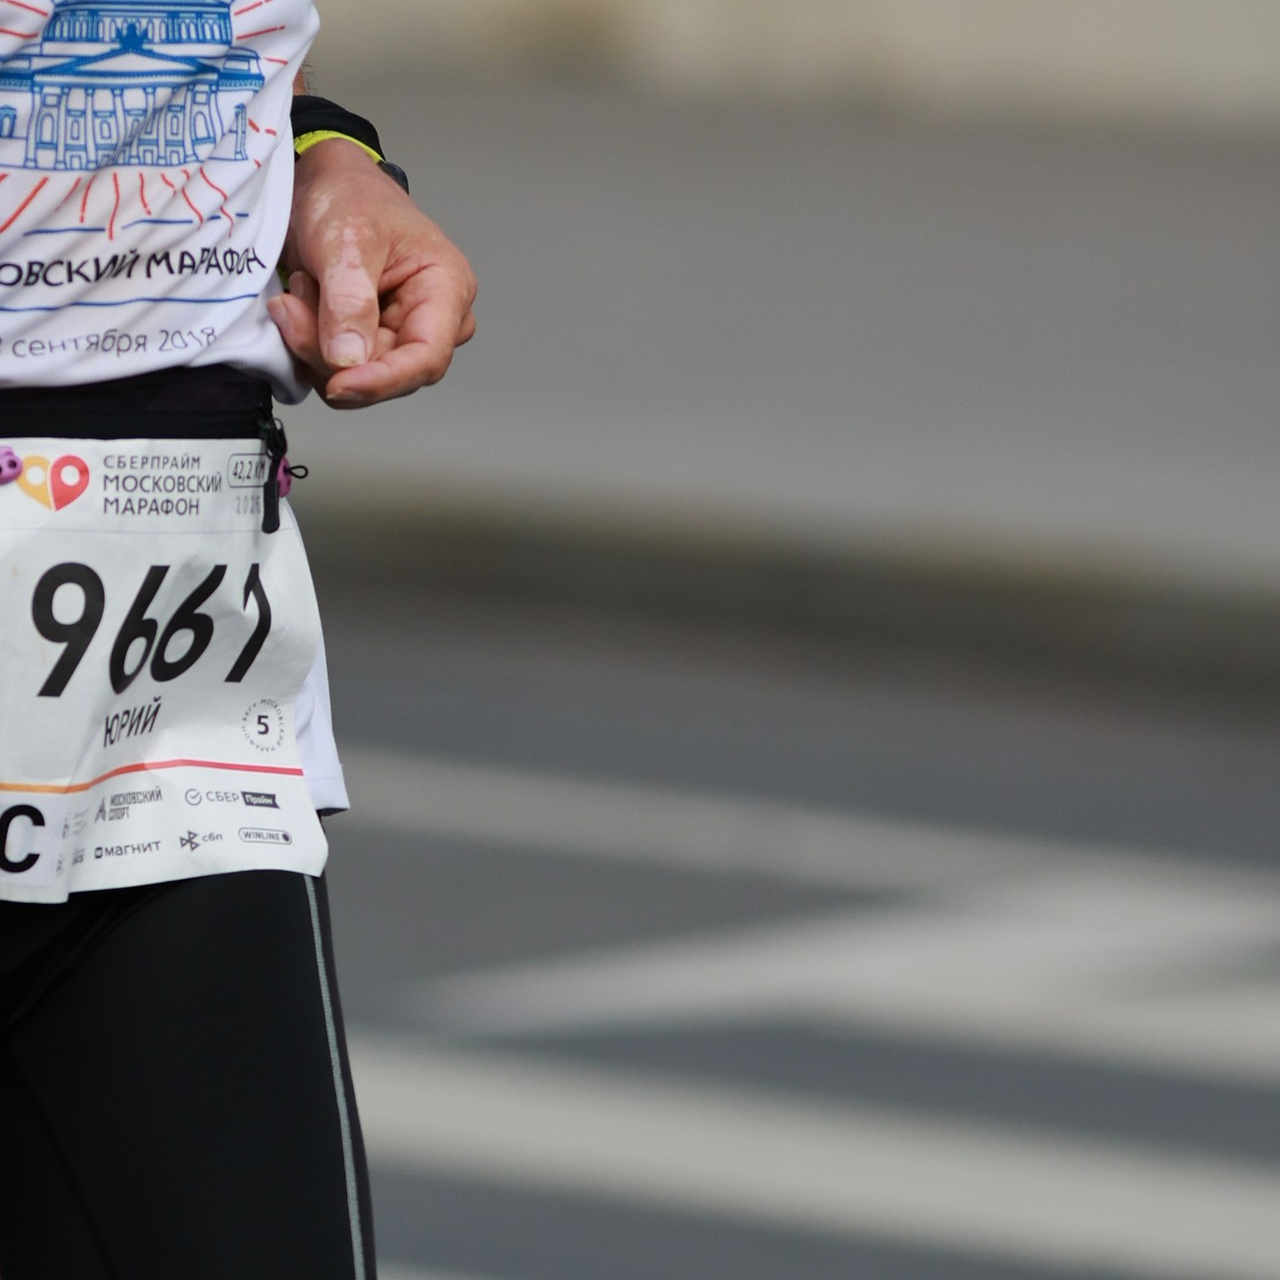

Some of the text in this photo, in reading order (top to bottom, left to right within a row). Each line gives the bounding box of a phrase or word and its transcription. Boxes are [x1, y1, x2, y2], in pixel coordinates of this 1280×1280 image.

[145, 246, 268, 280] МАРАФОН
[12, 327, 147, 358] сентября
[158, 326, 218, 352] 2018
[103, 453, 201, 470] СБЕРПРАЙМ
[232, 460, 253, 482] 42,2
[103, 472, 222, 493] МОСКОВСКИЙ
[103, 497, 200, 516] МАРАФОН
[103, 695, 162, 748] ЮРИЙ
[257, 714, 270, 736] 5
[206, 791, 240, 802] СБЕР
[243, 830, 280, 841] WINLINE
